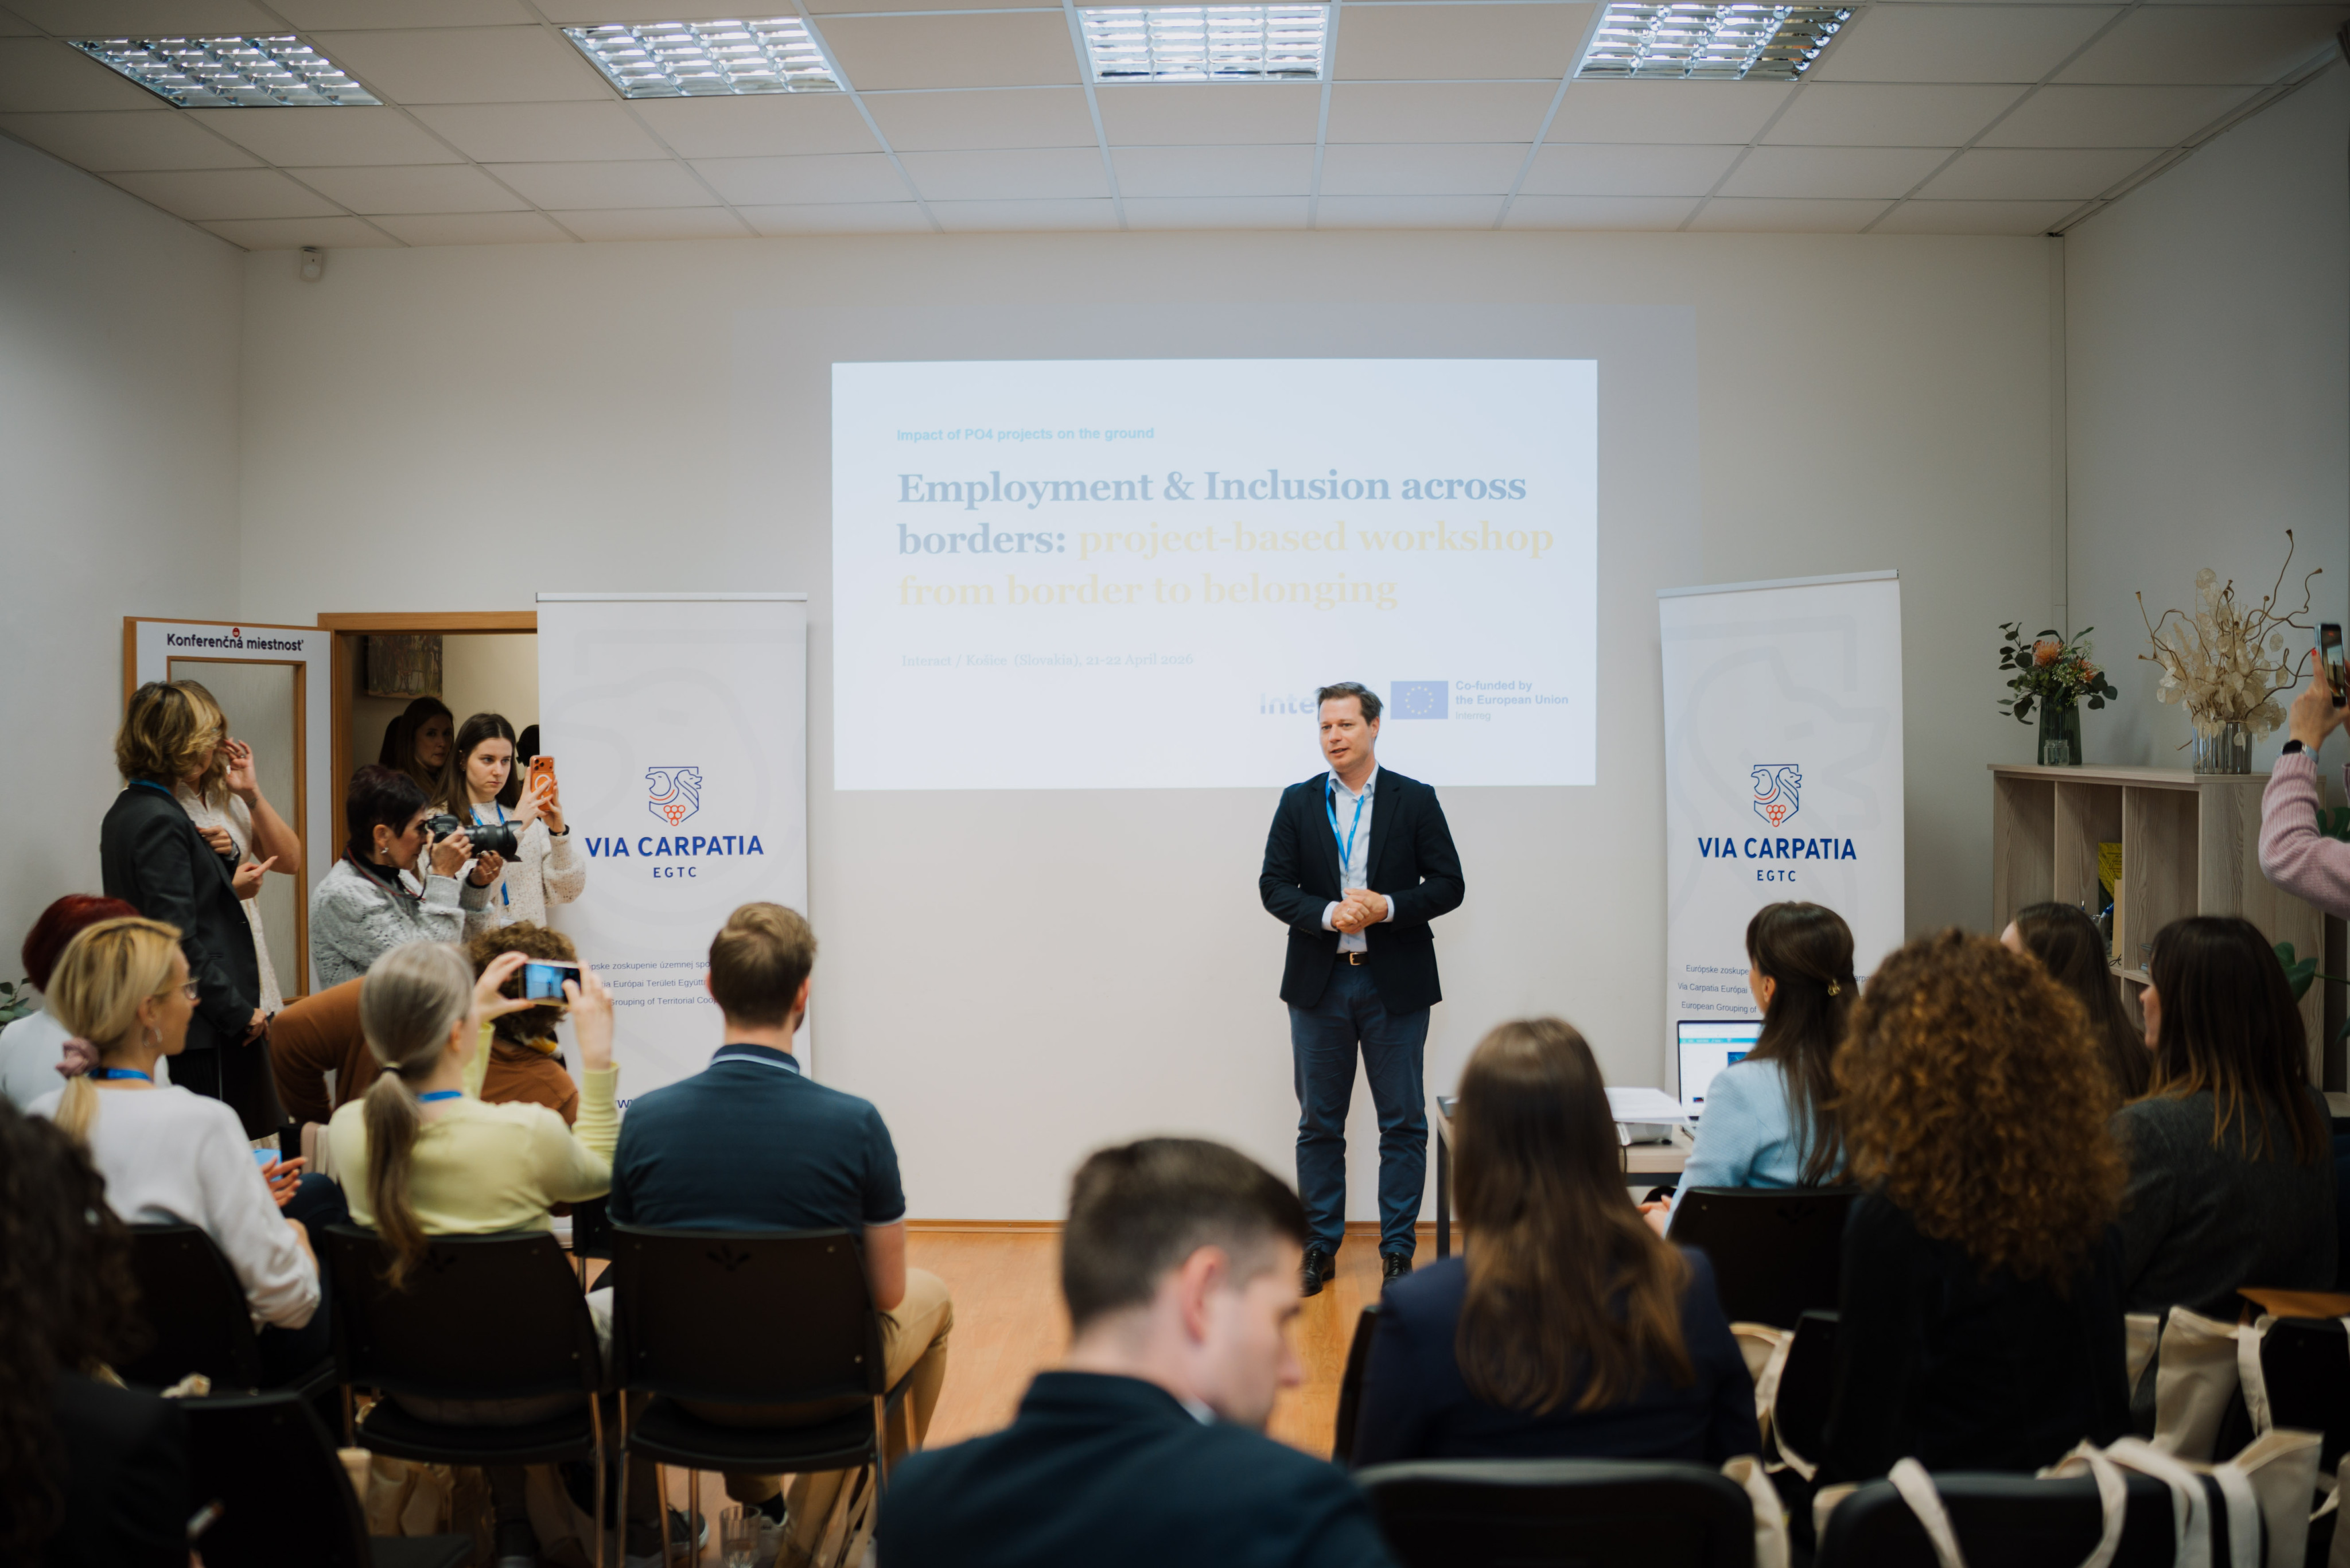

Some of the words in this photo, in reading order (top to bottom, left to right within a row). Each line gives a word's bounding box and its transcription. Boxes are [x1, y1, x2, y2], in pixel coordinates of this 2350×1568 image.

[897, 429, 944, 443] Impact
[947, 429, 962, 441] of
[964, 428, 994, 440] PO4
[997, 428, 1053, 442] projects
[1057, 430, 1075, 439] on
[1078, 427, 1101, 439] the
[1104, 427, 1154, 442] ground
[897, 470, 1154, 511] Employment
[1163, 470, 1195, 501] &
[1204, 468, 1391, 500] Inclusion
[1401, 478, 1527, 500] across
[897, 522, 1066, 555] borders:
[1078, 520, 1348, 561] project-based
[1358, 520, 1554, 559] workshop
[897, 574, 995, 606] from
[1005, 574, 1143, 605] border
[1153, 578, 1192, 604] to
[1203, 572, 1398, 611] belonging
[167, 633, 243, 648] Konferenčná
[247, 637, 304, 651] miestnosť
[901, 655, 952, 667] Interact
[966, 653, 1007, 666] Košice
[1014, 653, 1083, 668] (Slovakia),
[1085, 656, 1122, 666] 21-22
[1125, 652, 1157, 667] April
[1161, 653, 1194, 665] 2026
[1456, 680, 1515, 691] Co-funded
[1518, 680, 1533, 692] by
[1260, 692, 1316, 714] Inte
[1455, 695, 1473, 705] the
[1477, 694, 1532, 707] European
[1535, 694, 1569, 705] Union
[1455, 711, 1492, 722] Interreg
[585, 837, 630, 857] VIA
[637, 835, 764, 857] CARPATIA
[1698, 837, 1737, 858] VIA
[1744, 837, 1857, 860] CARPATIA
[653, 866, 697, 878] EGTC
[1757, 870, 1796, 882] EGTC
[612, 962, 657, 971] zoskupenie
[659, 961, 693, 970] územnej
[1686, 964, 1719, 974] Európske
[1720, 967, 1749, 976] zoskupe
[613, 980, 644, 989] Európai
[1678, 982, 1688, 990] Via
[1689, 983, 1719, 993] Carpatia
[1721, 985, 1748, 995] Európai
[647, 997, 655, 1005] of
[657, 997, 695, 1005] Territorial
[1681, 1001, 1714, 1011] European
[1716, 1003, 1749, 1014] Grouping
[1750, 1005, 1757, 1013] of
